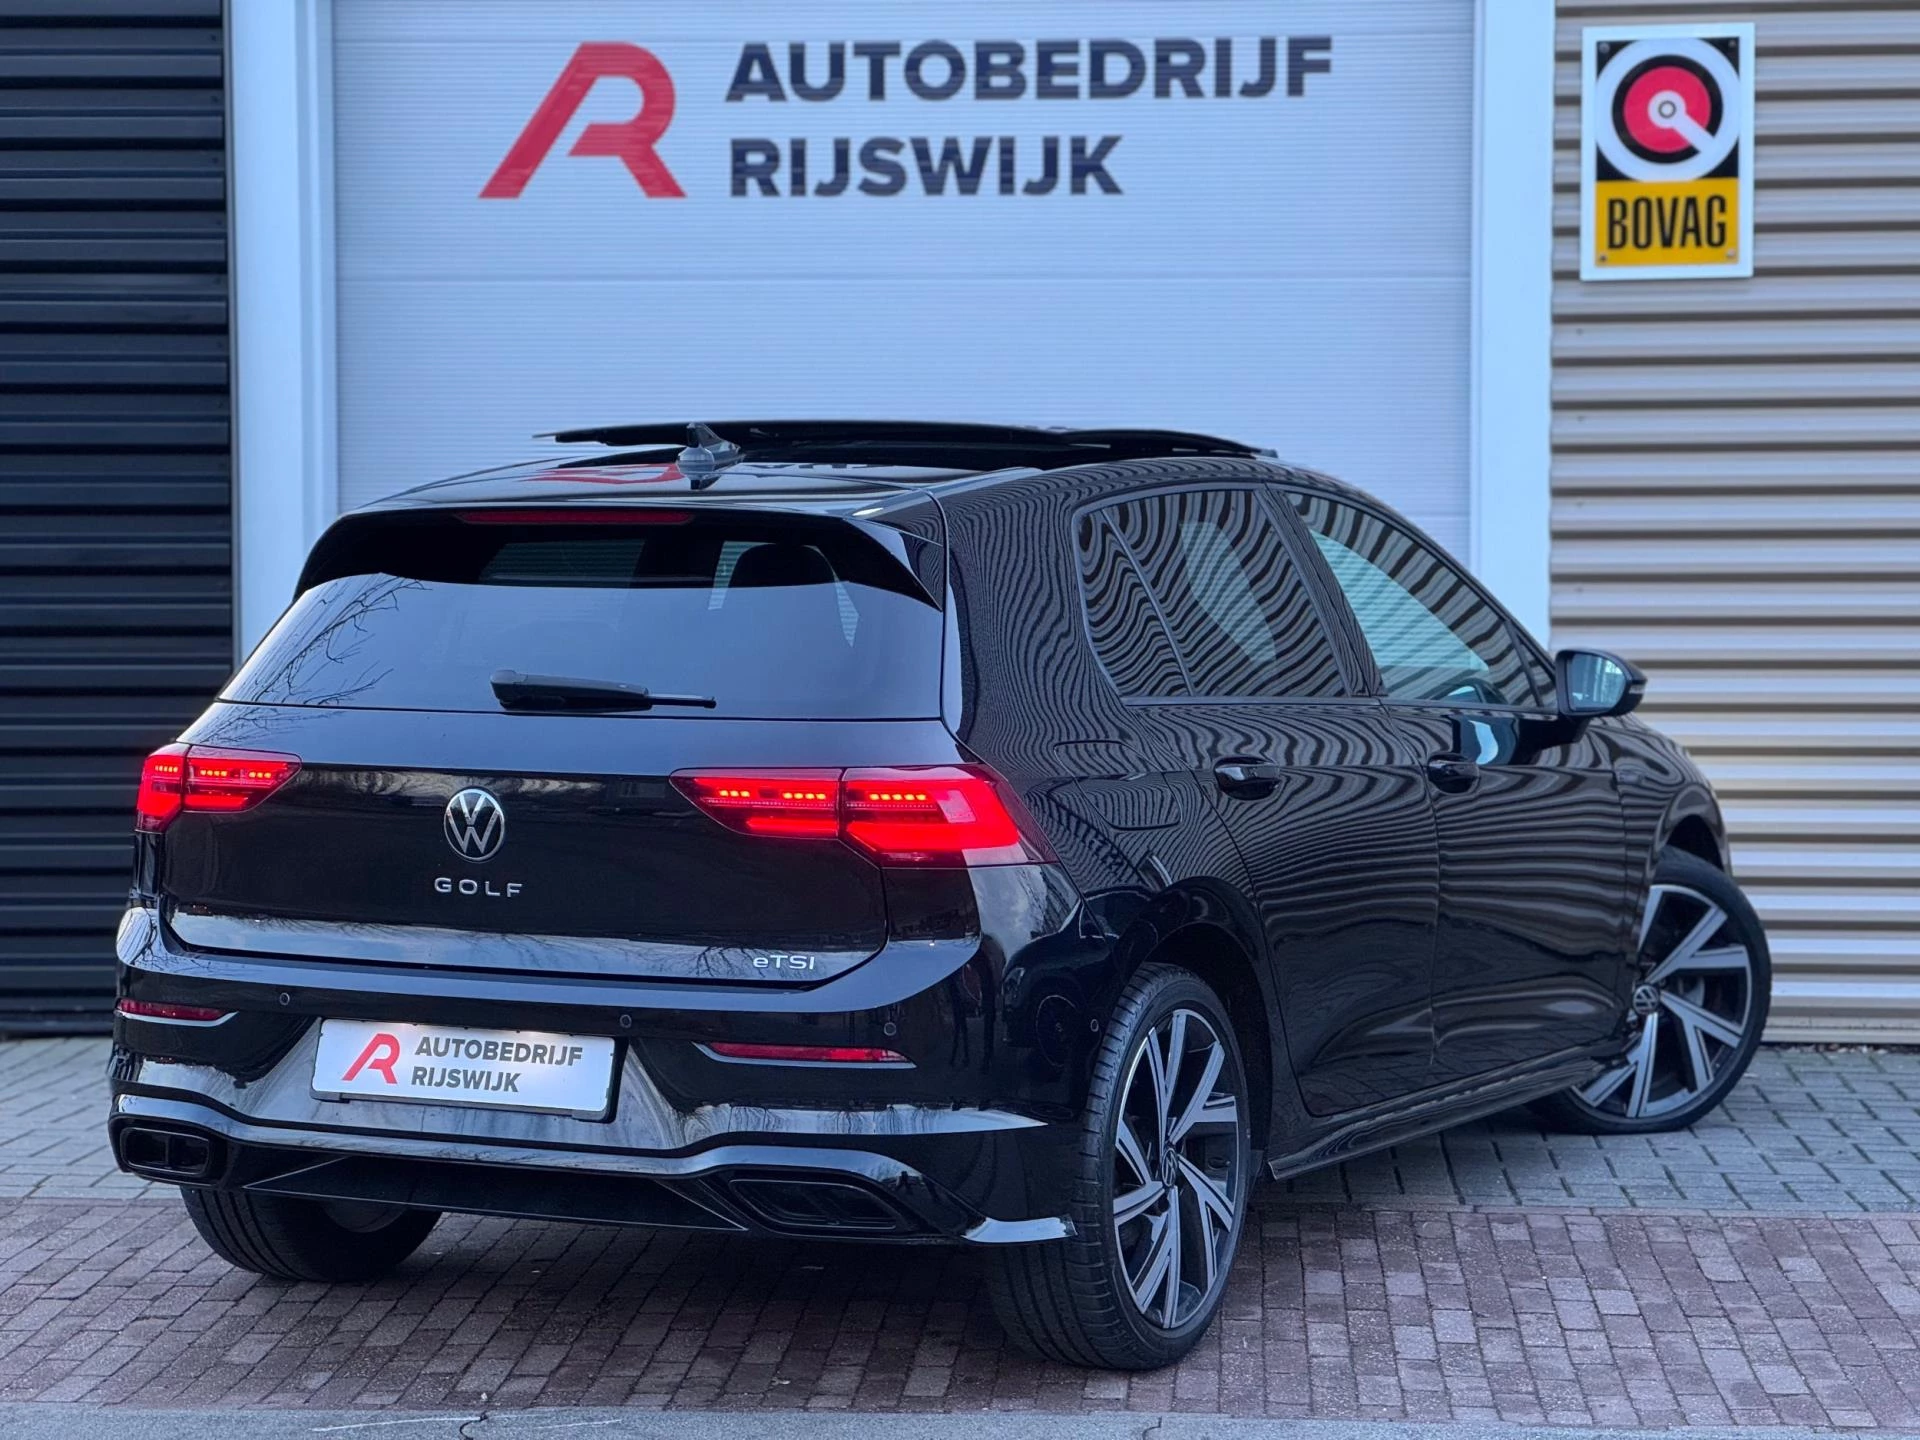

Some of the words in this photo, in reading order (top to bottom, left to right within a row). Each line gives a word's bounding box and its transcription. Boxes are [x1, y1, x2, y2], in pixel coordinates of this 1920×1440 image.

[725, 37, 1333, 102] AUTOBEDRIJF
[731, 136, 1124, 197] RIJSWIJK
[1608, 194, 1726, 249] BOVAG
[434, 877, 523, 898] GOLF
[752, 954, 815, 970] eTSI
[414, 1037, 583, 1066] AUTOBEDRIJF
[411, 1066, 521, 1093] RIJSWIJK
